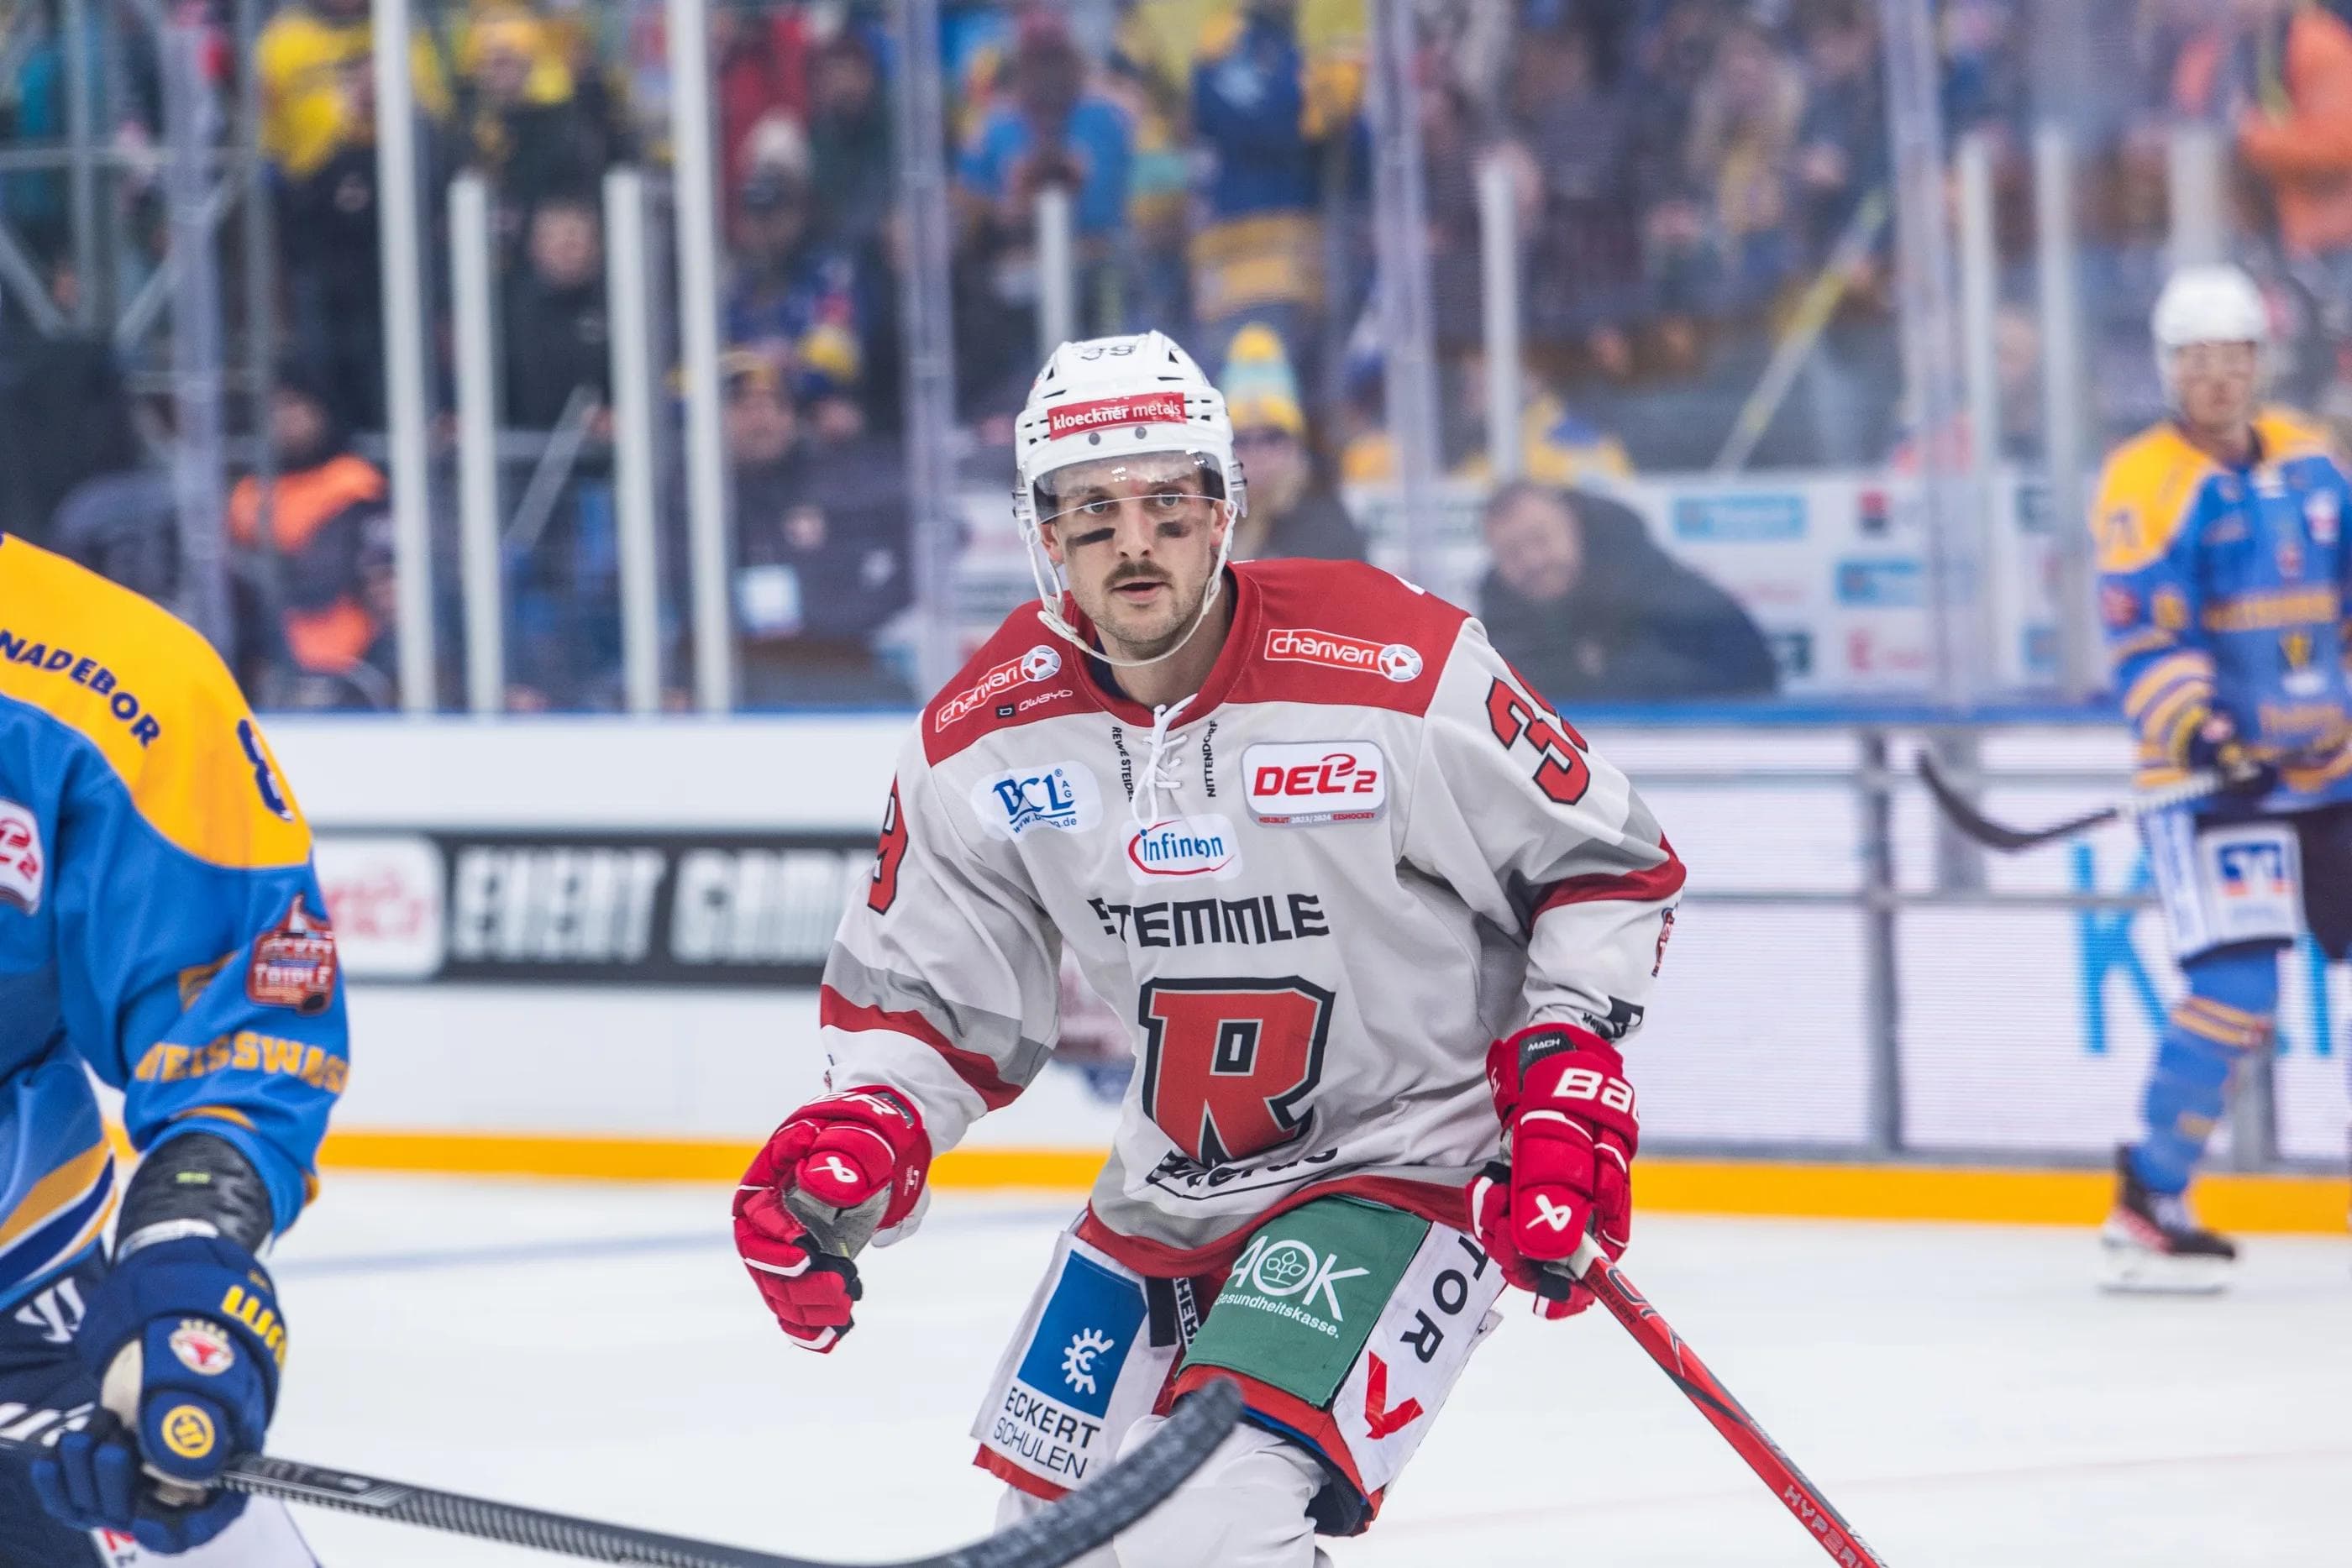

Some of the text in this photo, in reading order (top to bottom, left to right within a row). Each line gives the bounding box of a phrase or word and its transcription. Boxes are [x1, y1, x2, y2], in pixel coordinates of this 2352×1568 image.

[1053, 400, 1181, 431] kloeckner metals
[1273, 631, 1374, 666] charivari
[941, 664, 1018, 722] charivari
[1111, 726, 1130, 757] REWE
[1485, 650, 1591, 806] 3
[1202, 720, 1218, 798] NITTENDORF
[993, 773, 1075, 816] BCL
[1137, 974, 1336, 1169] R
[1527, 1038, 1561, 1051] MACH
[1228, 1235, 1370, 1322] AOK
[1005, 1386, 1100, 1449] ECKERT
[994, 1417, 1088, 1479] SCHULEN
